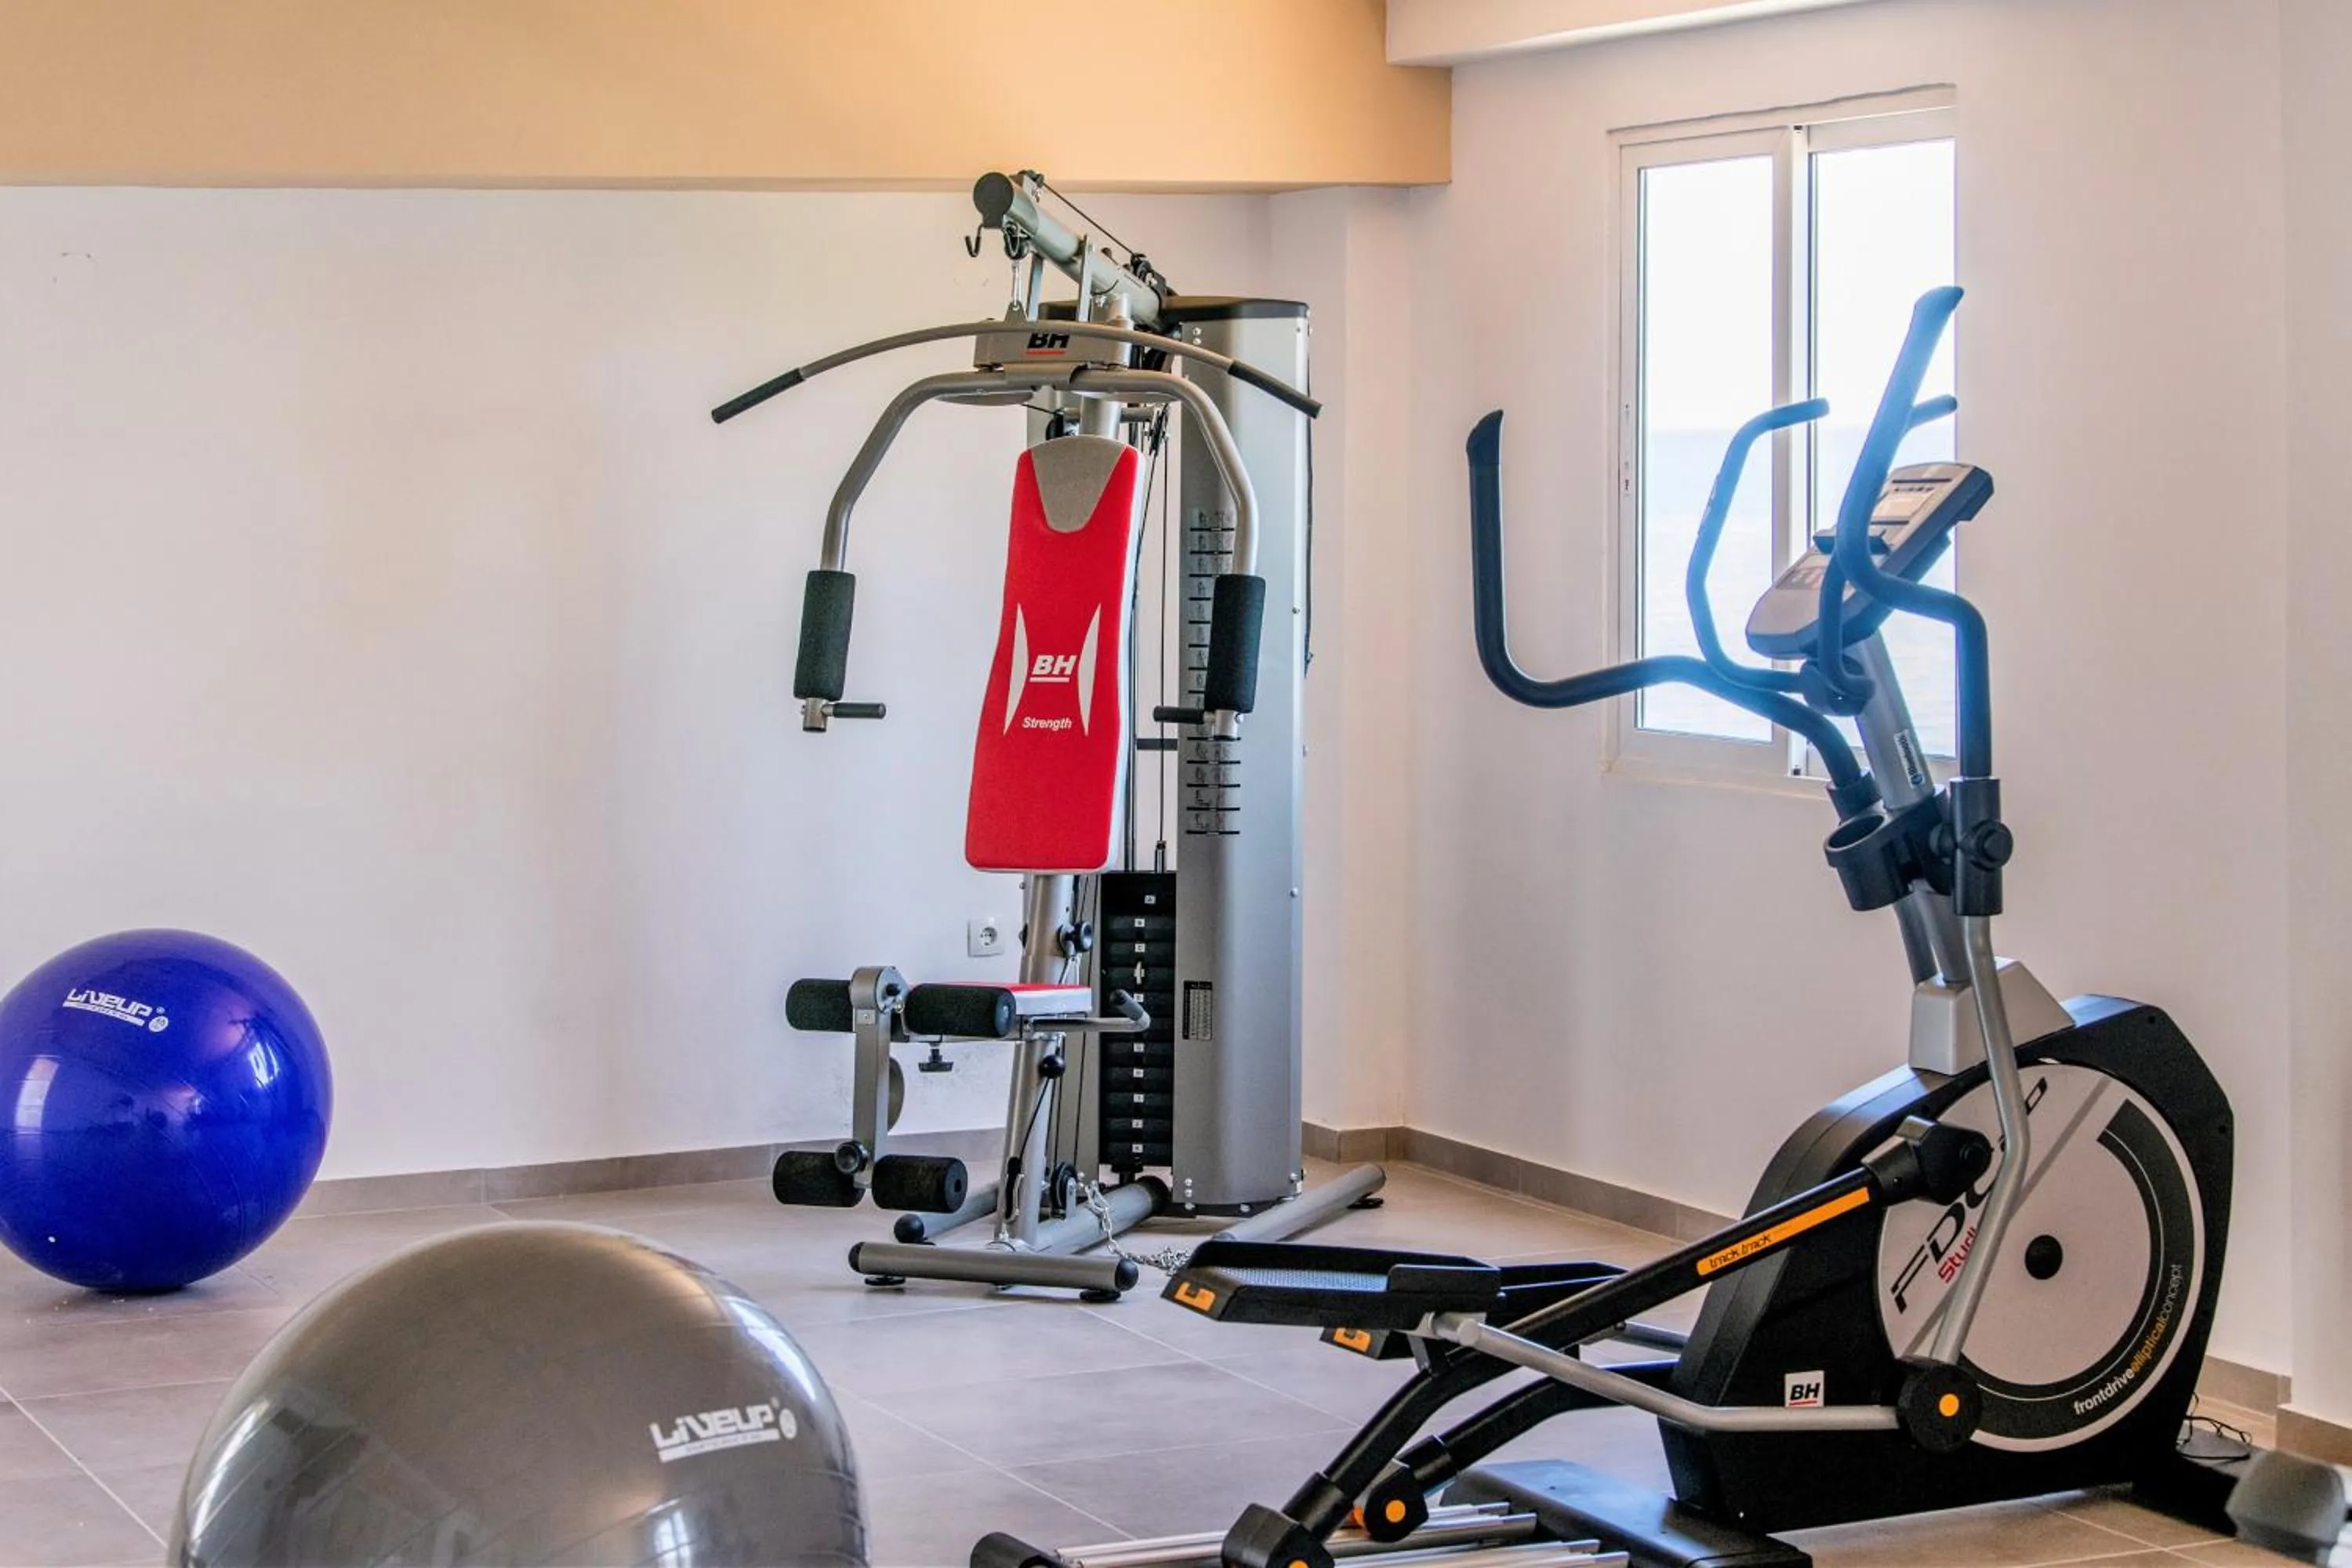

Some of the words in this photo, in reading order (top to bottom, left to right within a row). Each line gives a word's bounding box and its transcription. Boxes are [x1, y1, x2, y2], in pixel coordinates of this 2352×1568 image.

[1028, 332, 1070, 349] BH
[1032, 655, 1077, 675] BH
[1022, 717, 1073, 731] Strength
[1790, 1382, 1820, 1401] BH
